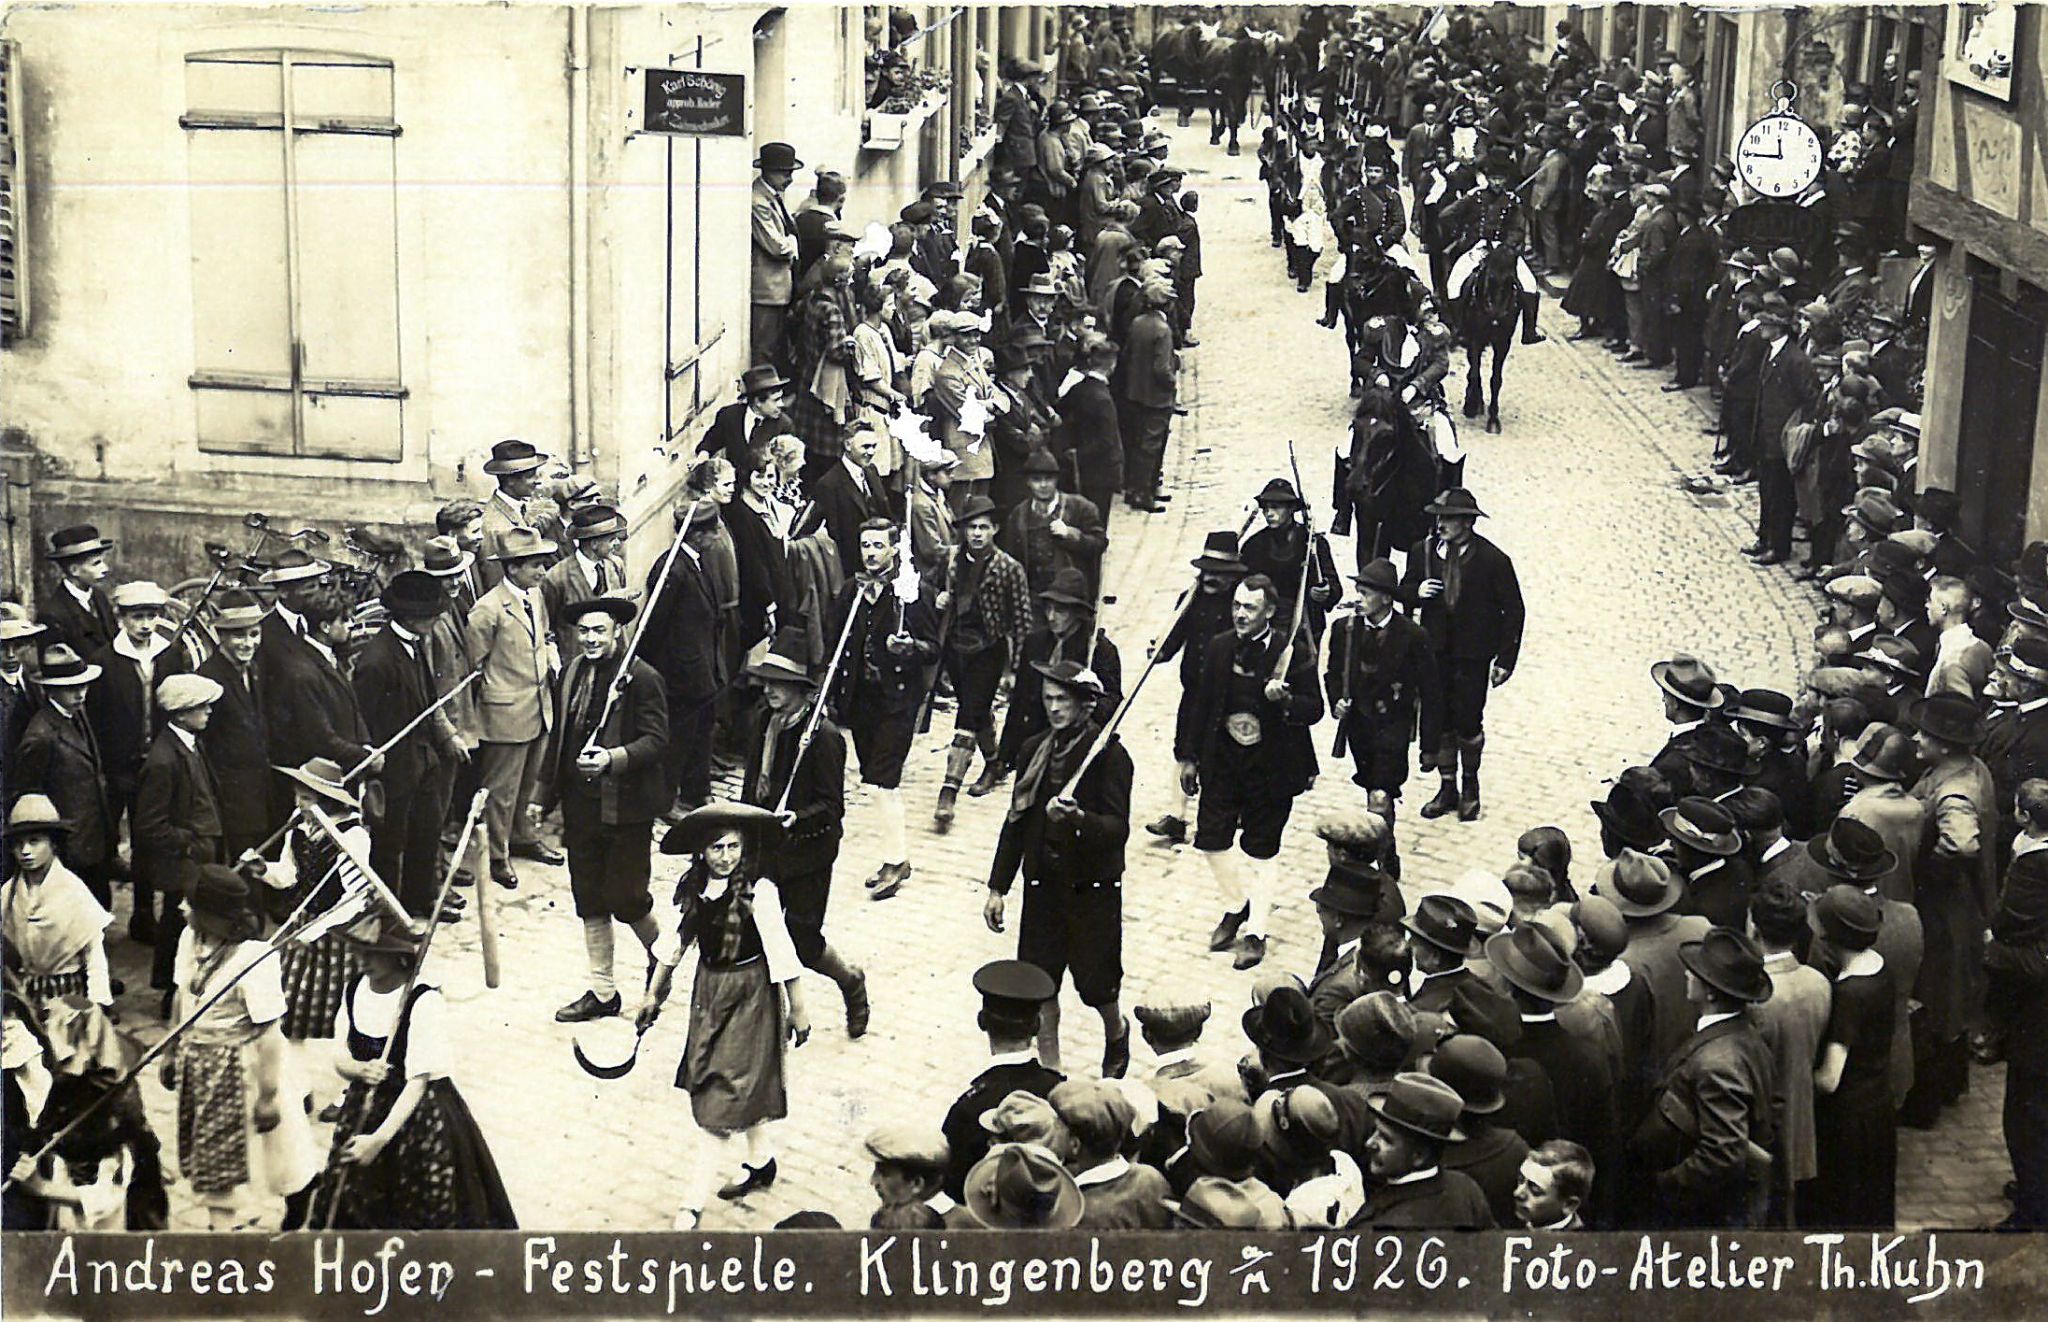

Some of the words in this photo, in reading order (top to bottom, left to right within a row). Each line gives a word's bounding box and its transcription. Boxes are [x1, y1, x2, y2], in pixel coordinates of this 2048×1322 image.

[660, 75, 685, 95] Karl
[1762, 125, 1771, 135] 11
[1778, 120, 1789, 131] 12
[1797, 126, 1802, 136] 1
[1750, 134, 1760, 145] 10
[1810, 154, 1817, 163] 3
[1746, 164, 1753, 175] 8
[1756, 176, 1762, 187] 7
[1792, 179, 1798, 189] 5
[1773, 182, 1780, 193] 6
